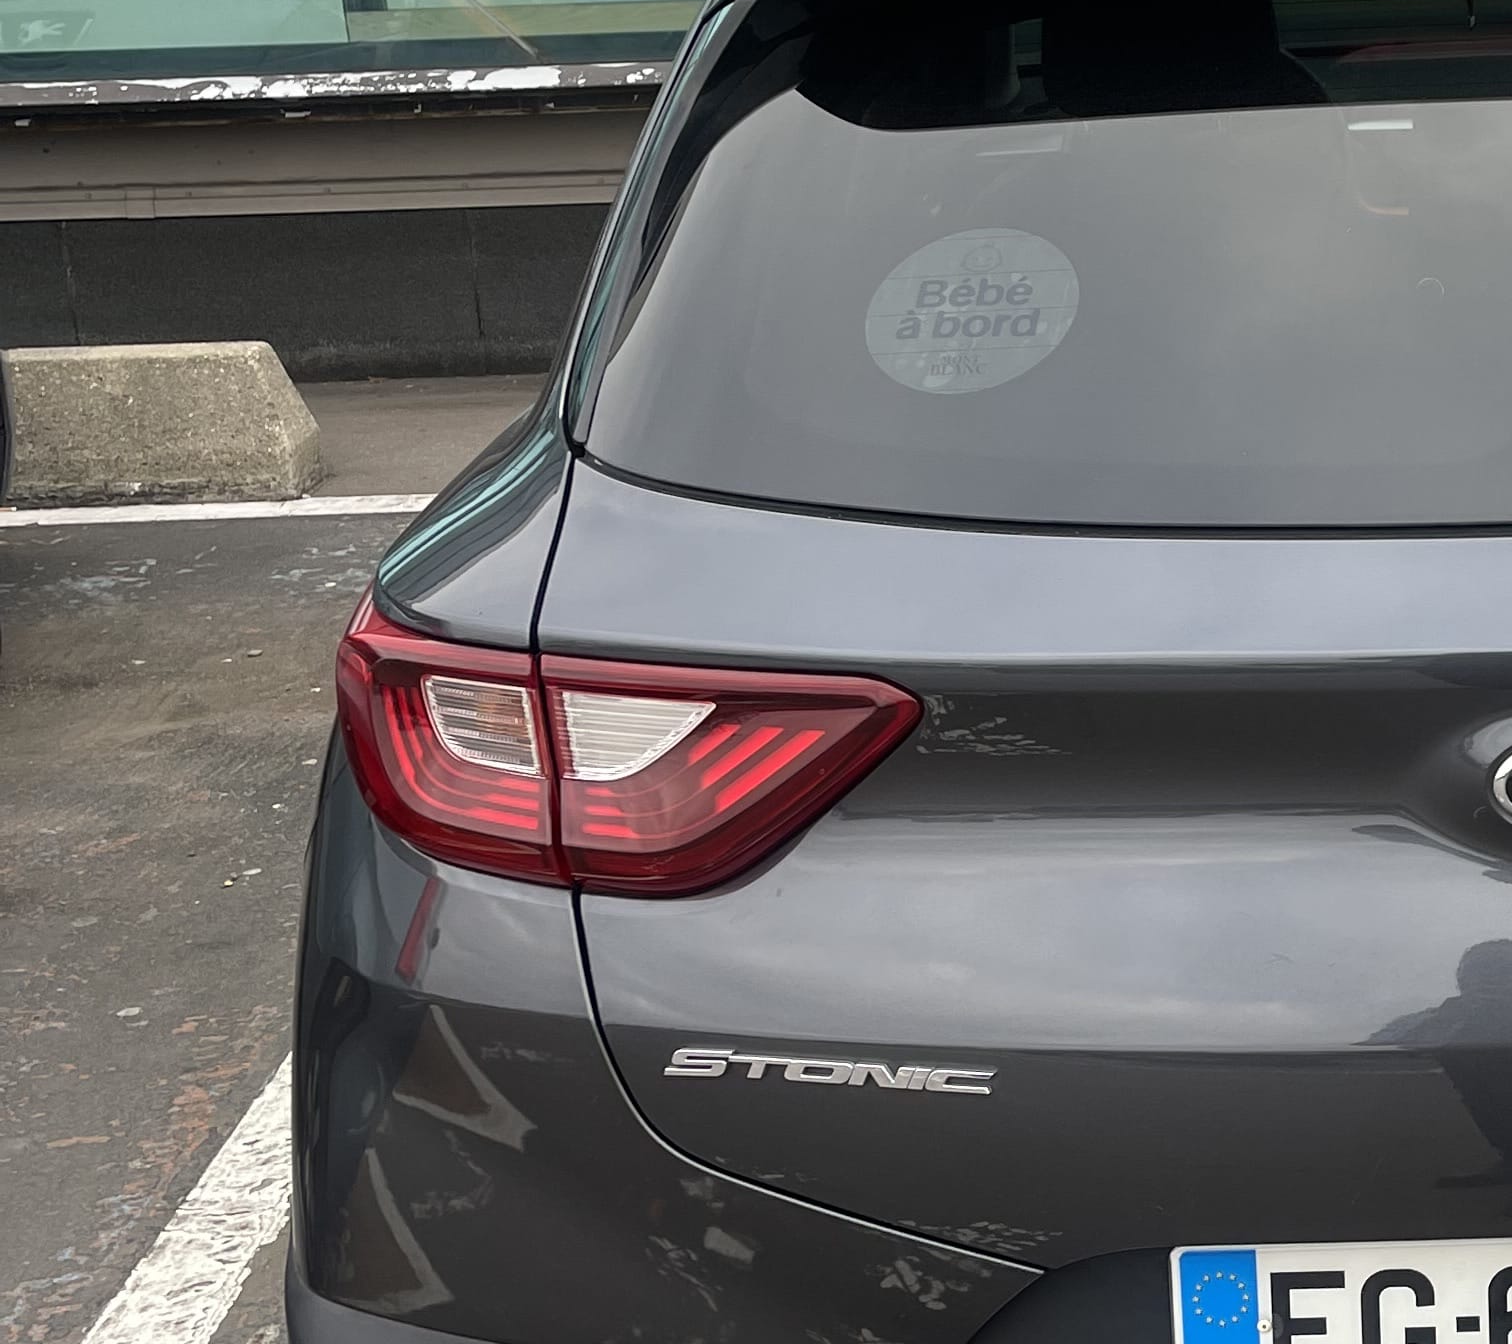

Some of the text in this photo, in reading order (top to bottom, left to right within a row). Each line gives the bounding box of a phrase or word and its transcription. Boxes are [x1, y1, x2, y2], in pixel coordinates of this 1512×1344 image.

[916, 275, 1033, 308] Bébé
[896, 307, 1041, 339] à bord
[664, 1047, 998, 1095] STONIC
